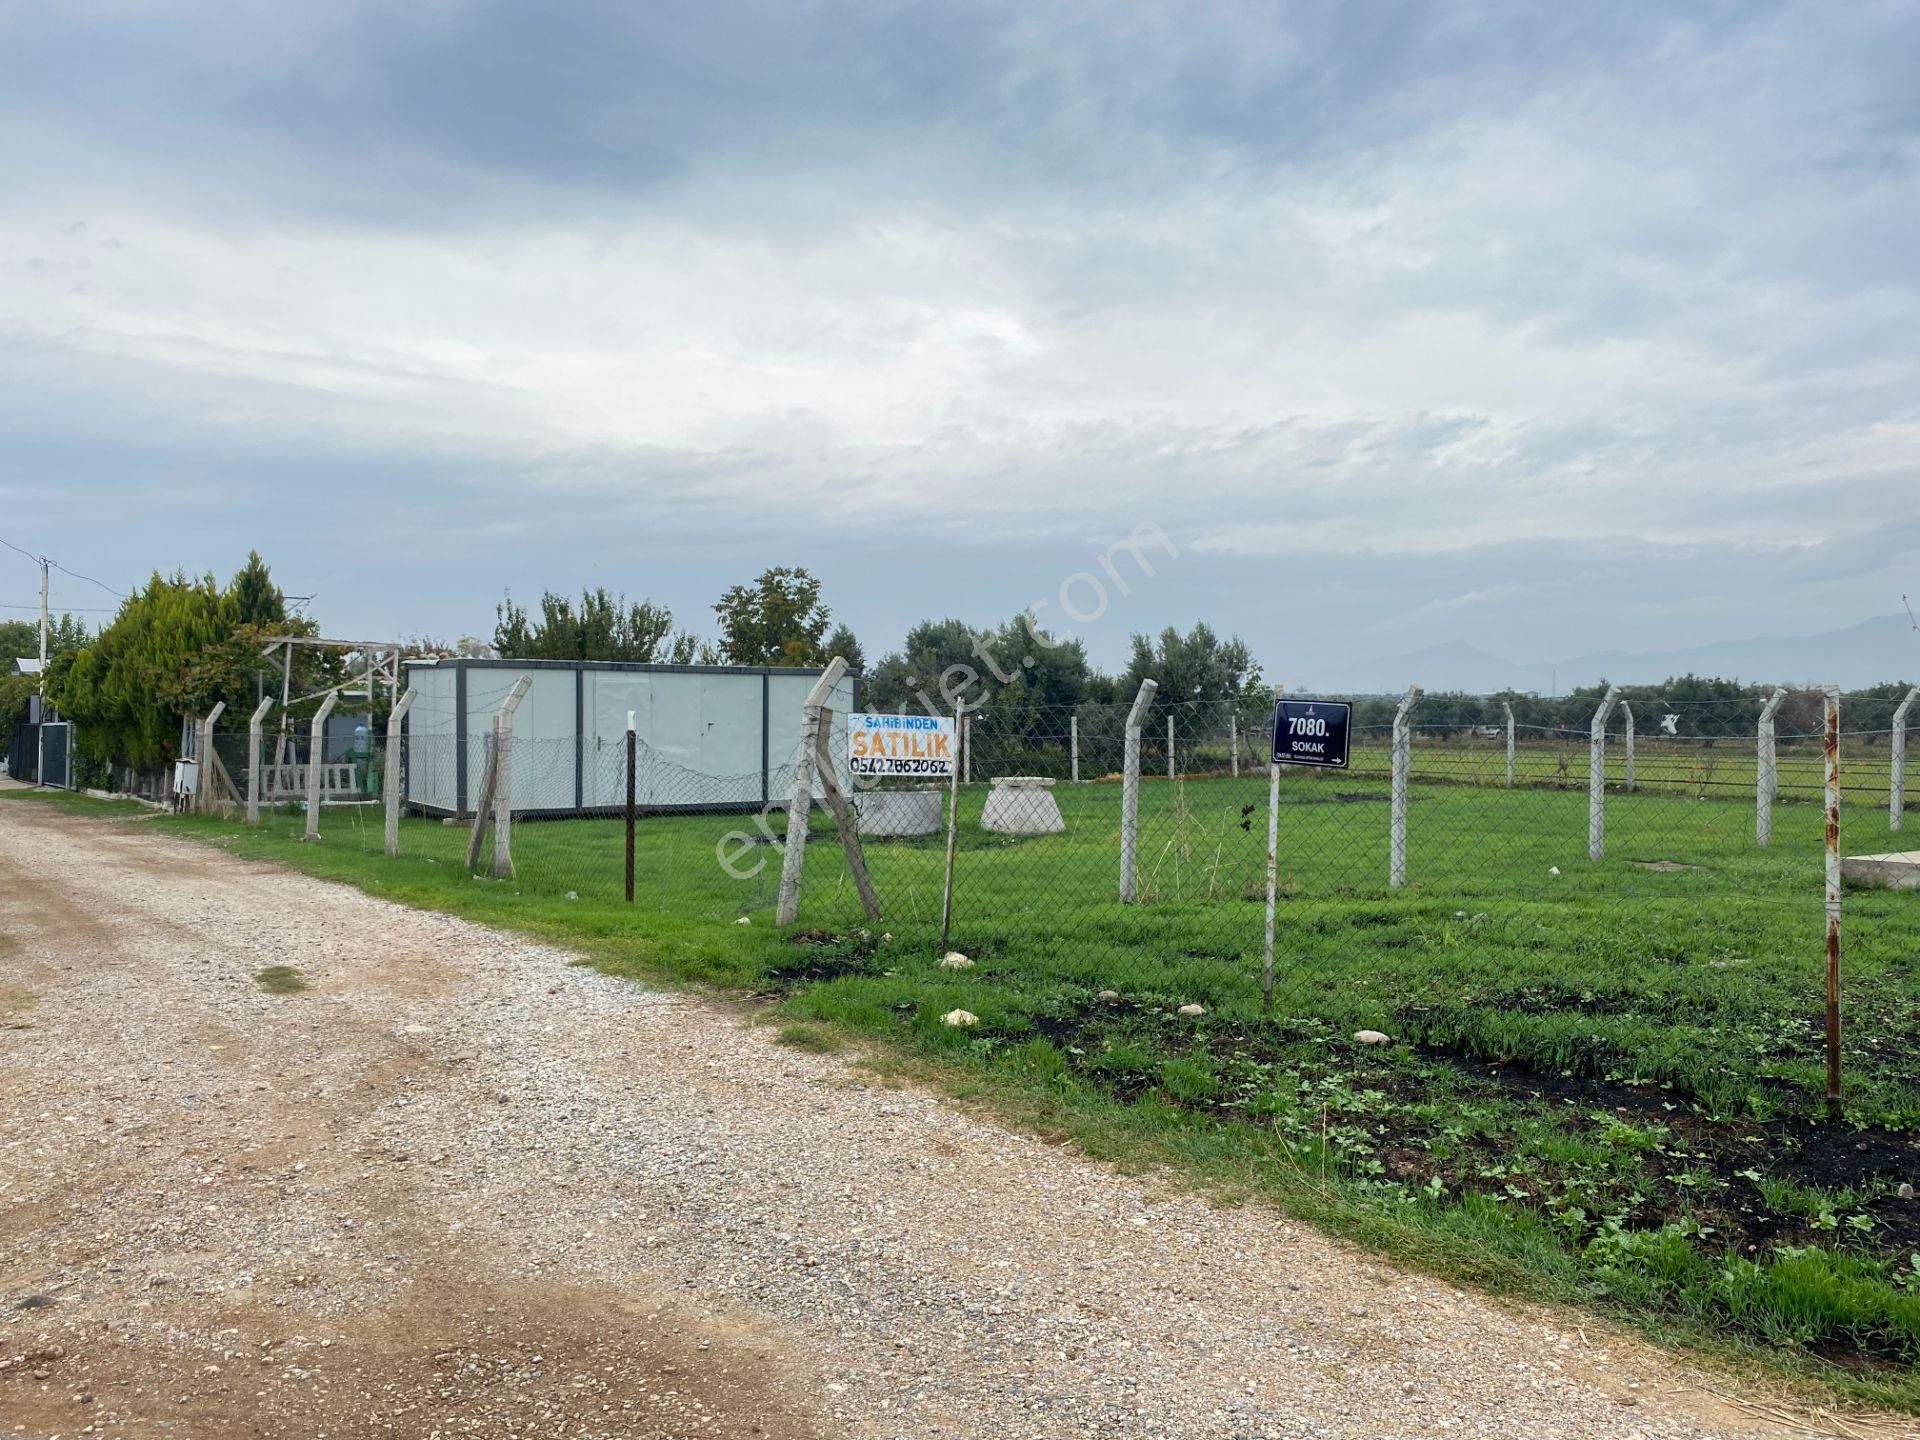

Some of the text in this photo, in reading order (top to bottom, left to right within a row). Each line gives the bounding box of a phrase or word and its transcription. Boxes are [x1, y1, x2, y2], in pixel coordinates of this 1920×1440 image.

[1288, 717, 1330, 737] 7080.
[852, 731, 951, 758] SATILIK
[1291, 741, 1325, 753] SOKAK
